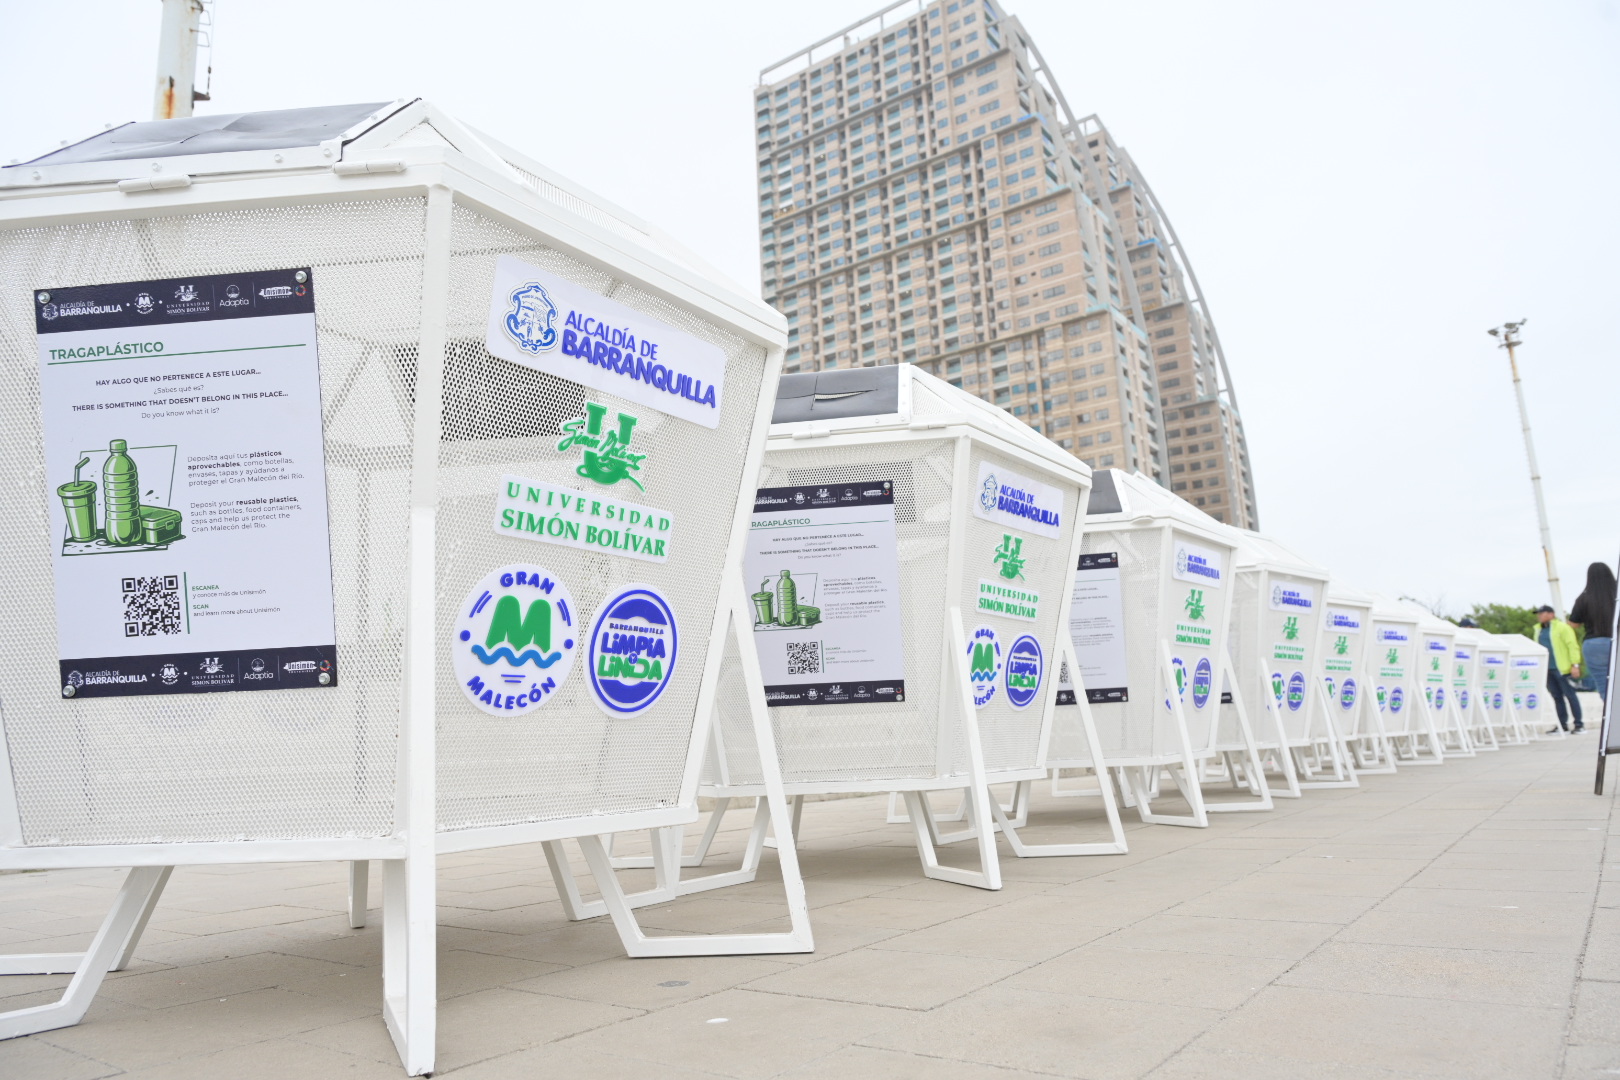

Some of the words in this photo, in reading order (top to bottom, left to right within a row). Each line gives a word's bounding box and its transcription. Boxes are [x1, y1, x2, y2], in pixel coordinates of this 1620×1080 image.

[60, 301, 86, 309] ALCALDÍA
[220, 298, 249, 307] Adaptia
[60, 304, 122, 317] BARRANQUILLA
[564, 310, 636, 352] ALCALDÍA
[640, 340, 658, 360] DE
[50, 341, 163, 360] TRAGAPLÁSTICO
[561, 329, 715, 408] BARRANQUILLA
[105, 401, 147, 409] SOMETHING
[250, 450, 282, 459] plásticos
[246, 467, 279, 475] ayúdanos
[189, 479, 219, 487] proteger
[248, 474, 276, 482] Malecón
[1000, 485, 1025, 502] ALCALDÍA
[1027, 494, 1034, 504] DE
[191, 501, 216, 509] Deposit
[507, 481, 670, 531] UNIVERSIDAD
[998, 495, 1059, 527] BARRANQUILLA
[211, 523, 239, 531] Malecón
[500, 508, 580, 541] SIMÓN
[586, 525, 666, 557] BOLÍVAR
[500, 571, 554, 594] GRAN
[981, 584, 1038, 603] UNIVERSIDAD
[979, 597, 1004, 612] SIMÓN
[1005, 603, 1036, 618] BOLÍVAR
[609, 623, 664, 634] BARRANQUILLA
[85, 675, 147, 685] BARRANQUILLA
[244, 671, 273, 680] Adaptia
[467, 675, 556, 709] MALECÓN
